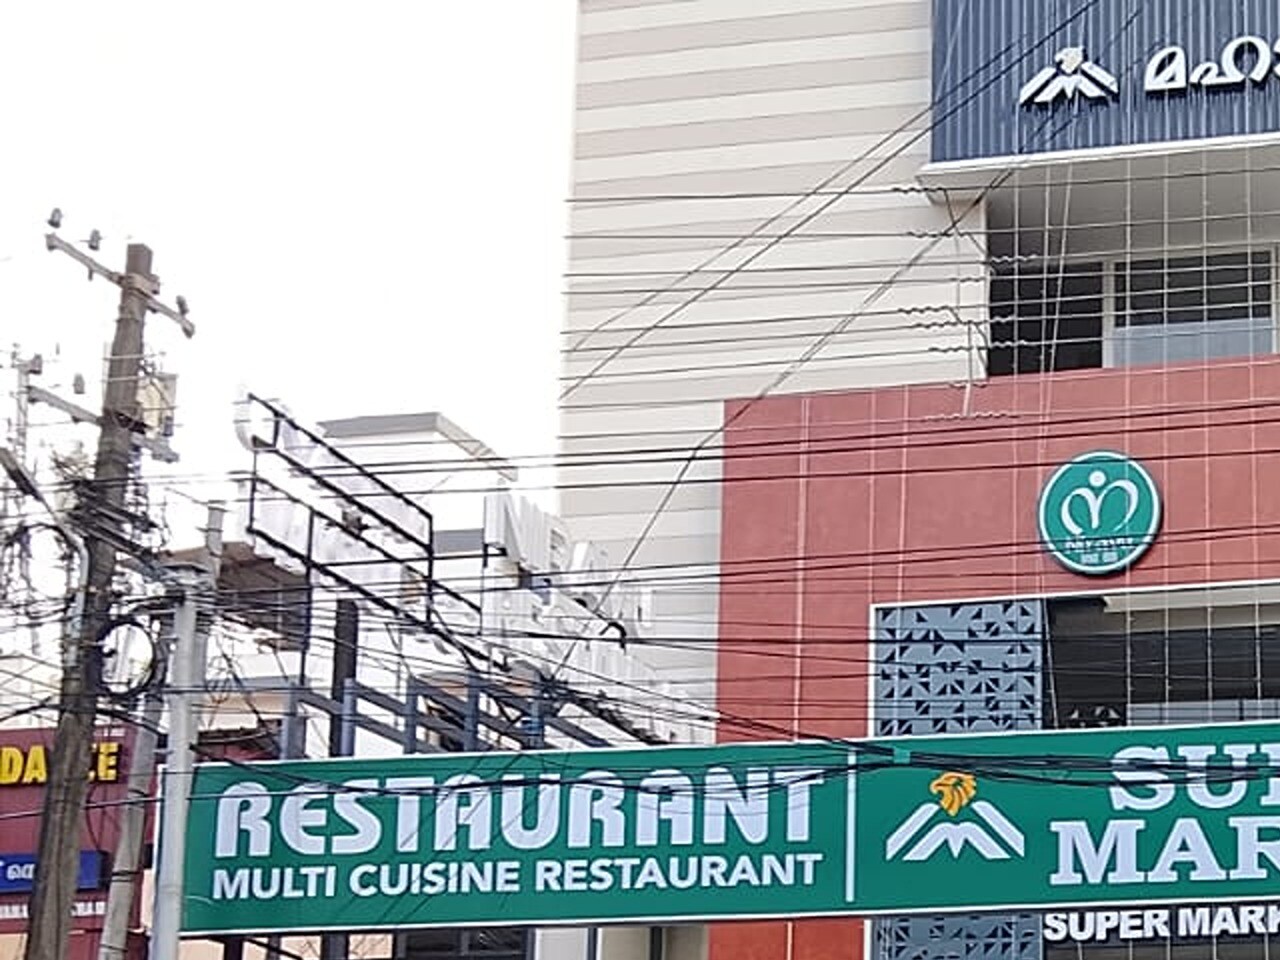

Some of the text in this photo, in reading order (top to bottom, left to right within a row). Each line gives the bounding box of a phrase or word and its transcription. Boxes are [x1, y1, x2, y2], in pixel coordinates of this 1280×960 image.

[214, 767, 825, 857] RESTAURANT
[212, 853, 823, 900] MULTI CUISINE RESTAURANT
[1043, 909, 1170, 941] SUPER
